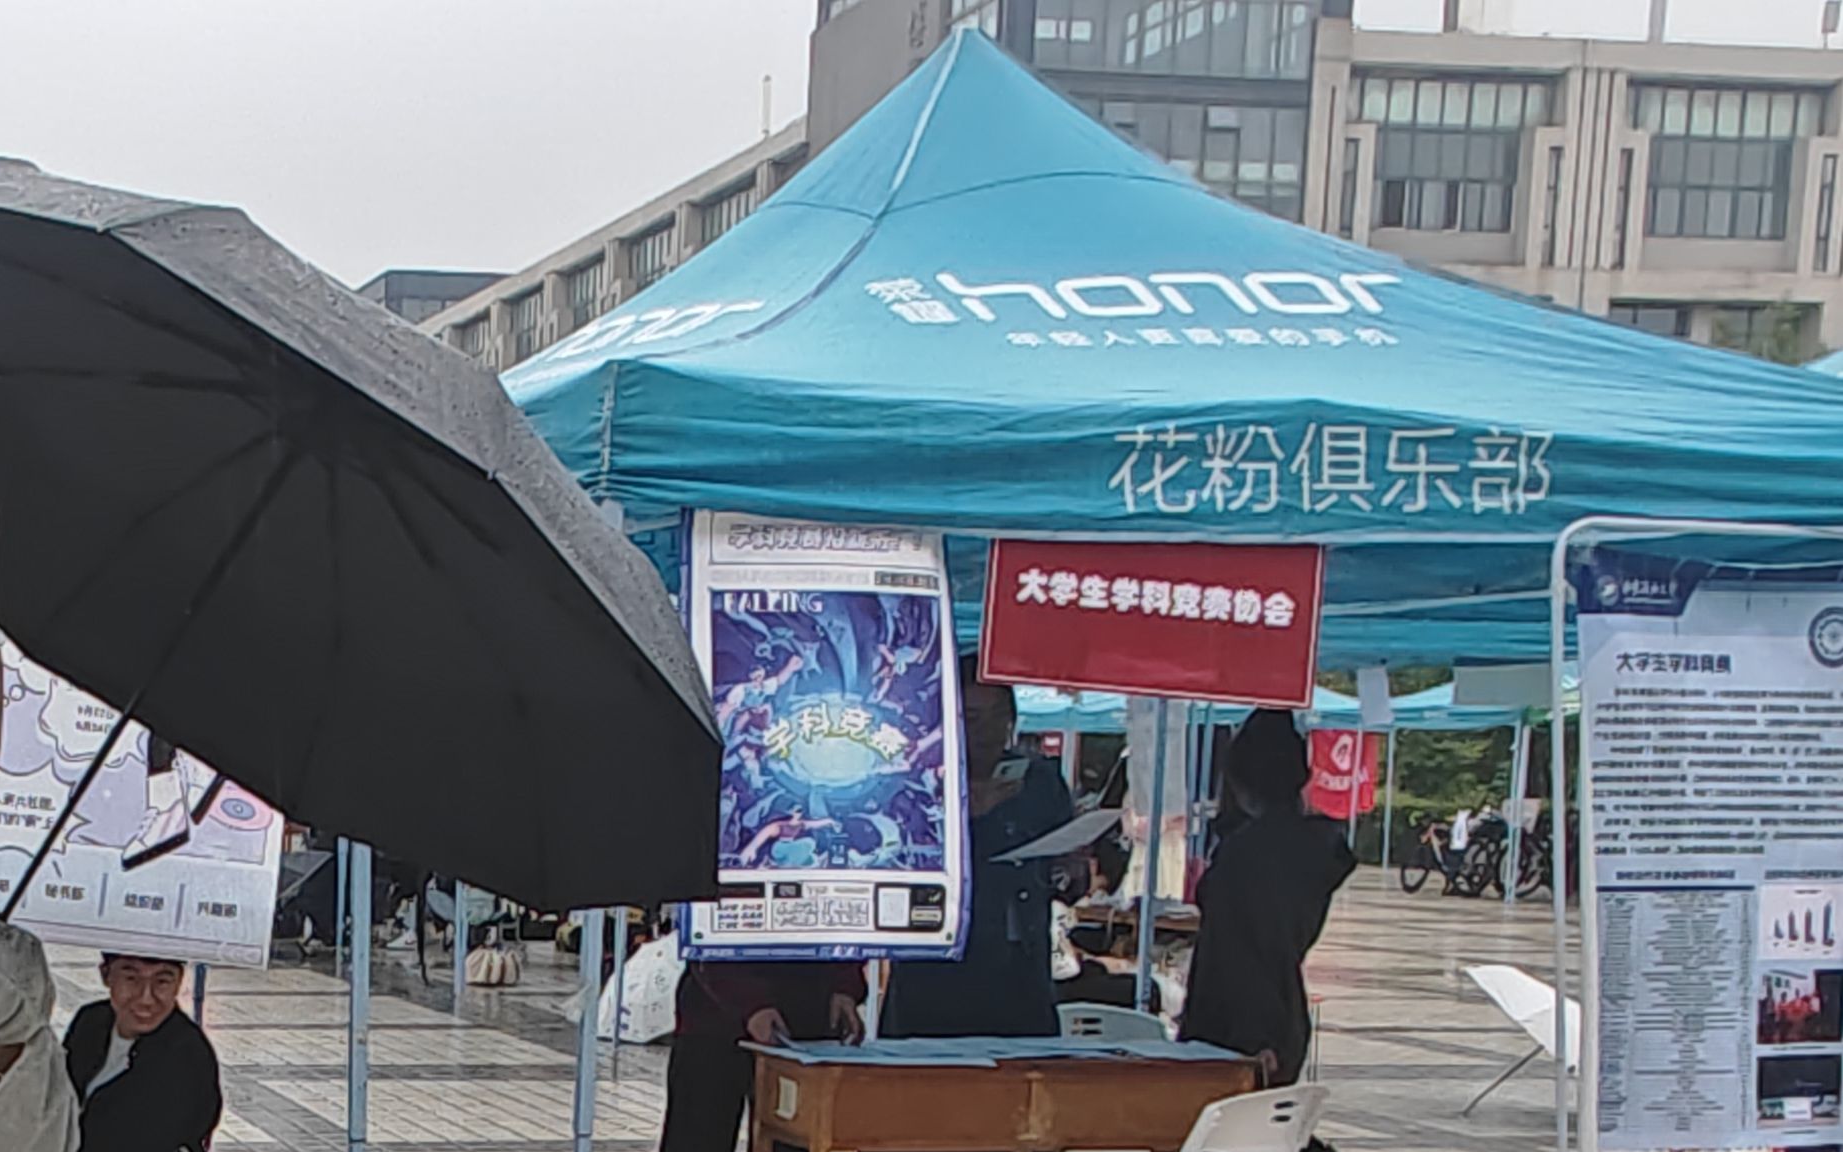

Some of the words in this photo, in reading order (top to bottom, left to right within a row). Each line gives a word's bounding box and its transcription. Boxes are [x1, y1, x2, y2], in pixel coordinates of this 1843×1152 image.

[936, 271, 1402, 321] honor
[1108, 422, 1555, 515] 花粉俱乐部
[1015, 567, 1297, 629] 大学生学科竞赛协会
